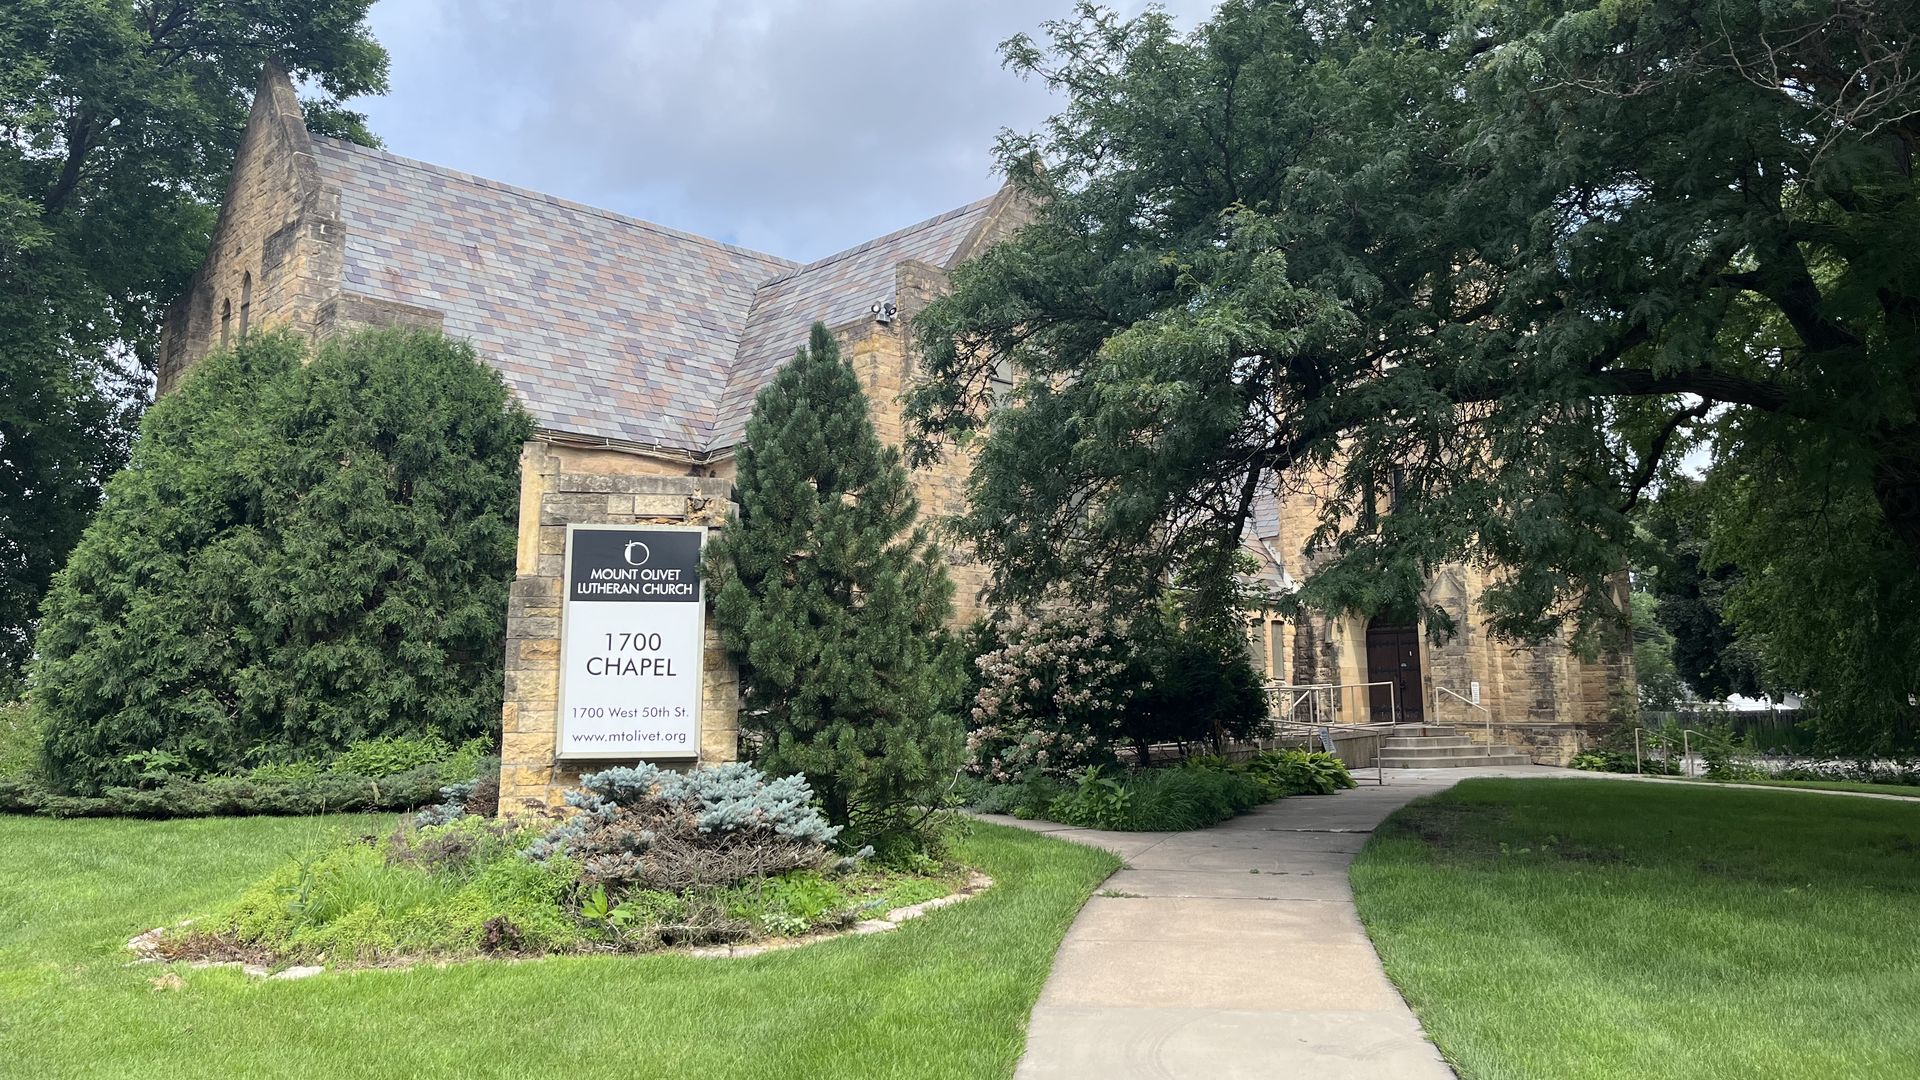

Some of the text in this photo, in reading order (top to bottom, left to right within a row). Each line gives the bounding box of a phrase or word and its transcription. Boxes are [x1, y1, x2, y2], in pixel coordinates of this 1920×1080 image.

[590, 568, 681, 581] MOUNT OLIVET
[577, 582, 693, 595] LUTHERAN CHURCH
[605, 633, 662, 651] 1700
[586, 657, 677, 677] CHAPEL
[572, 706, 689, 719] 1700 West 50th St.
[572, 730, 687, 744] www.mtolivet.org
